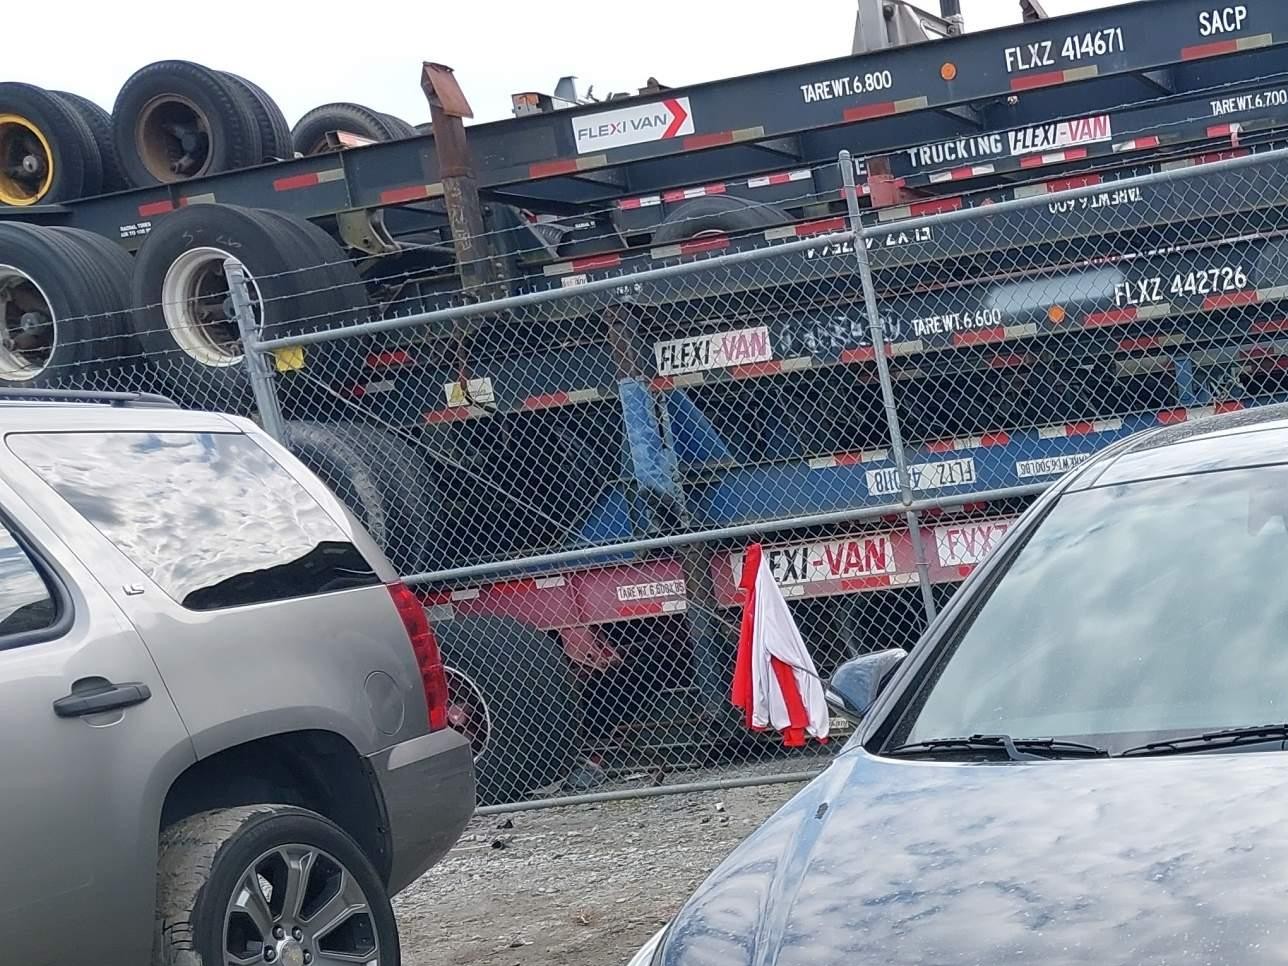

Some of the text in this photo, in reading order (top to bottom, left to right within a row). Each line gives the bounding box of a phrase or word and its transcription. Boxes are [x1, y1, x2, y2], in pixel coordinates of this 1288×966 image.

[1199, 6, 1247, 36] SACP
[1005, 28, 1124, 72] FLXZ 414671
[578, 113, 667, 140] FLEXI VAN
[1012, 116, 1108, 151] FLEXI-VAN
[907, 135, 1003, 168] TRUCKING
[1114, 266, 1247, 306] FLXZ 442726
[660, 333, 767, 372] FLEXI-VAN
